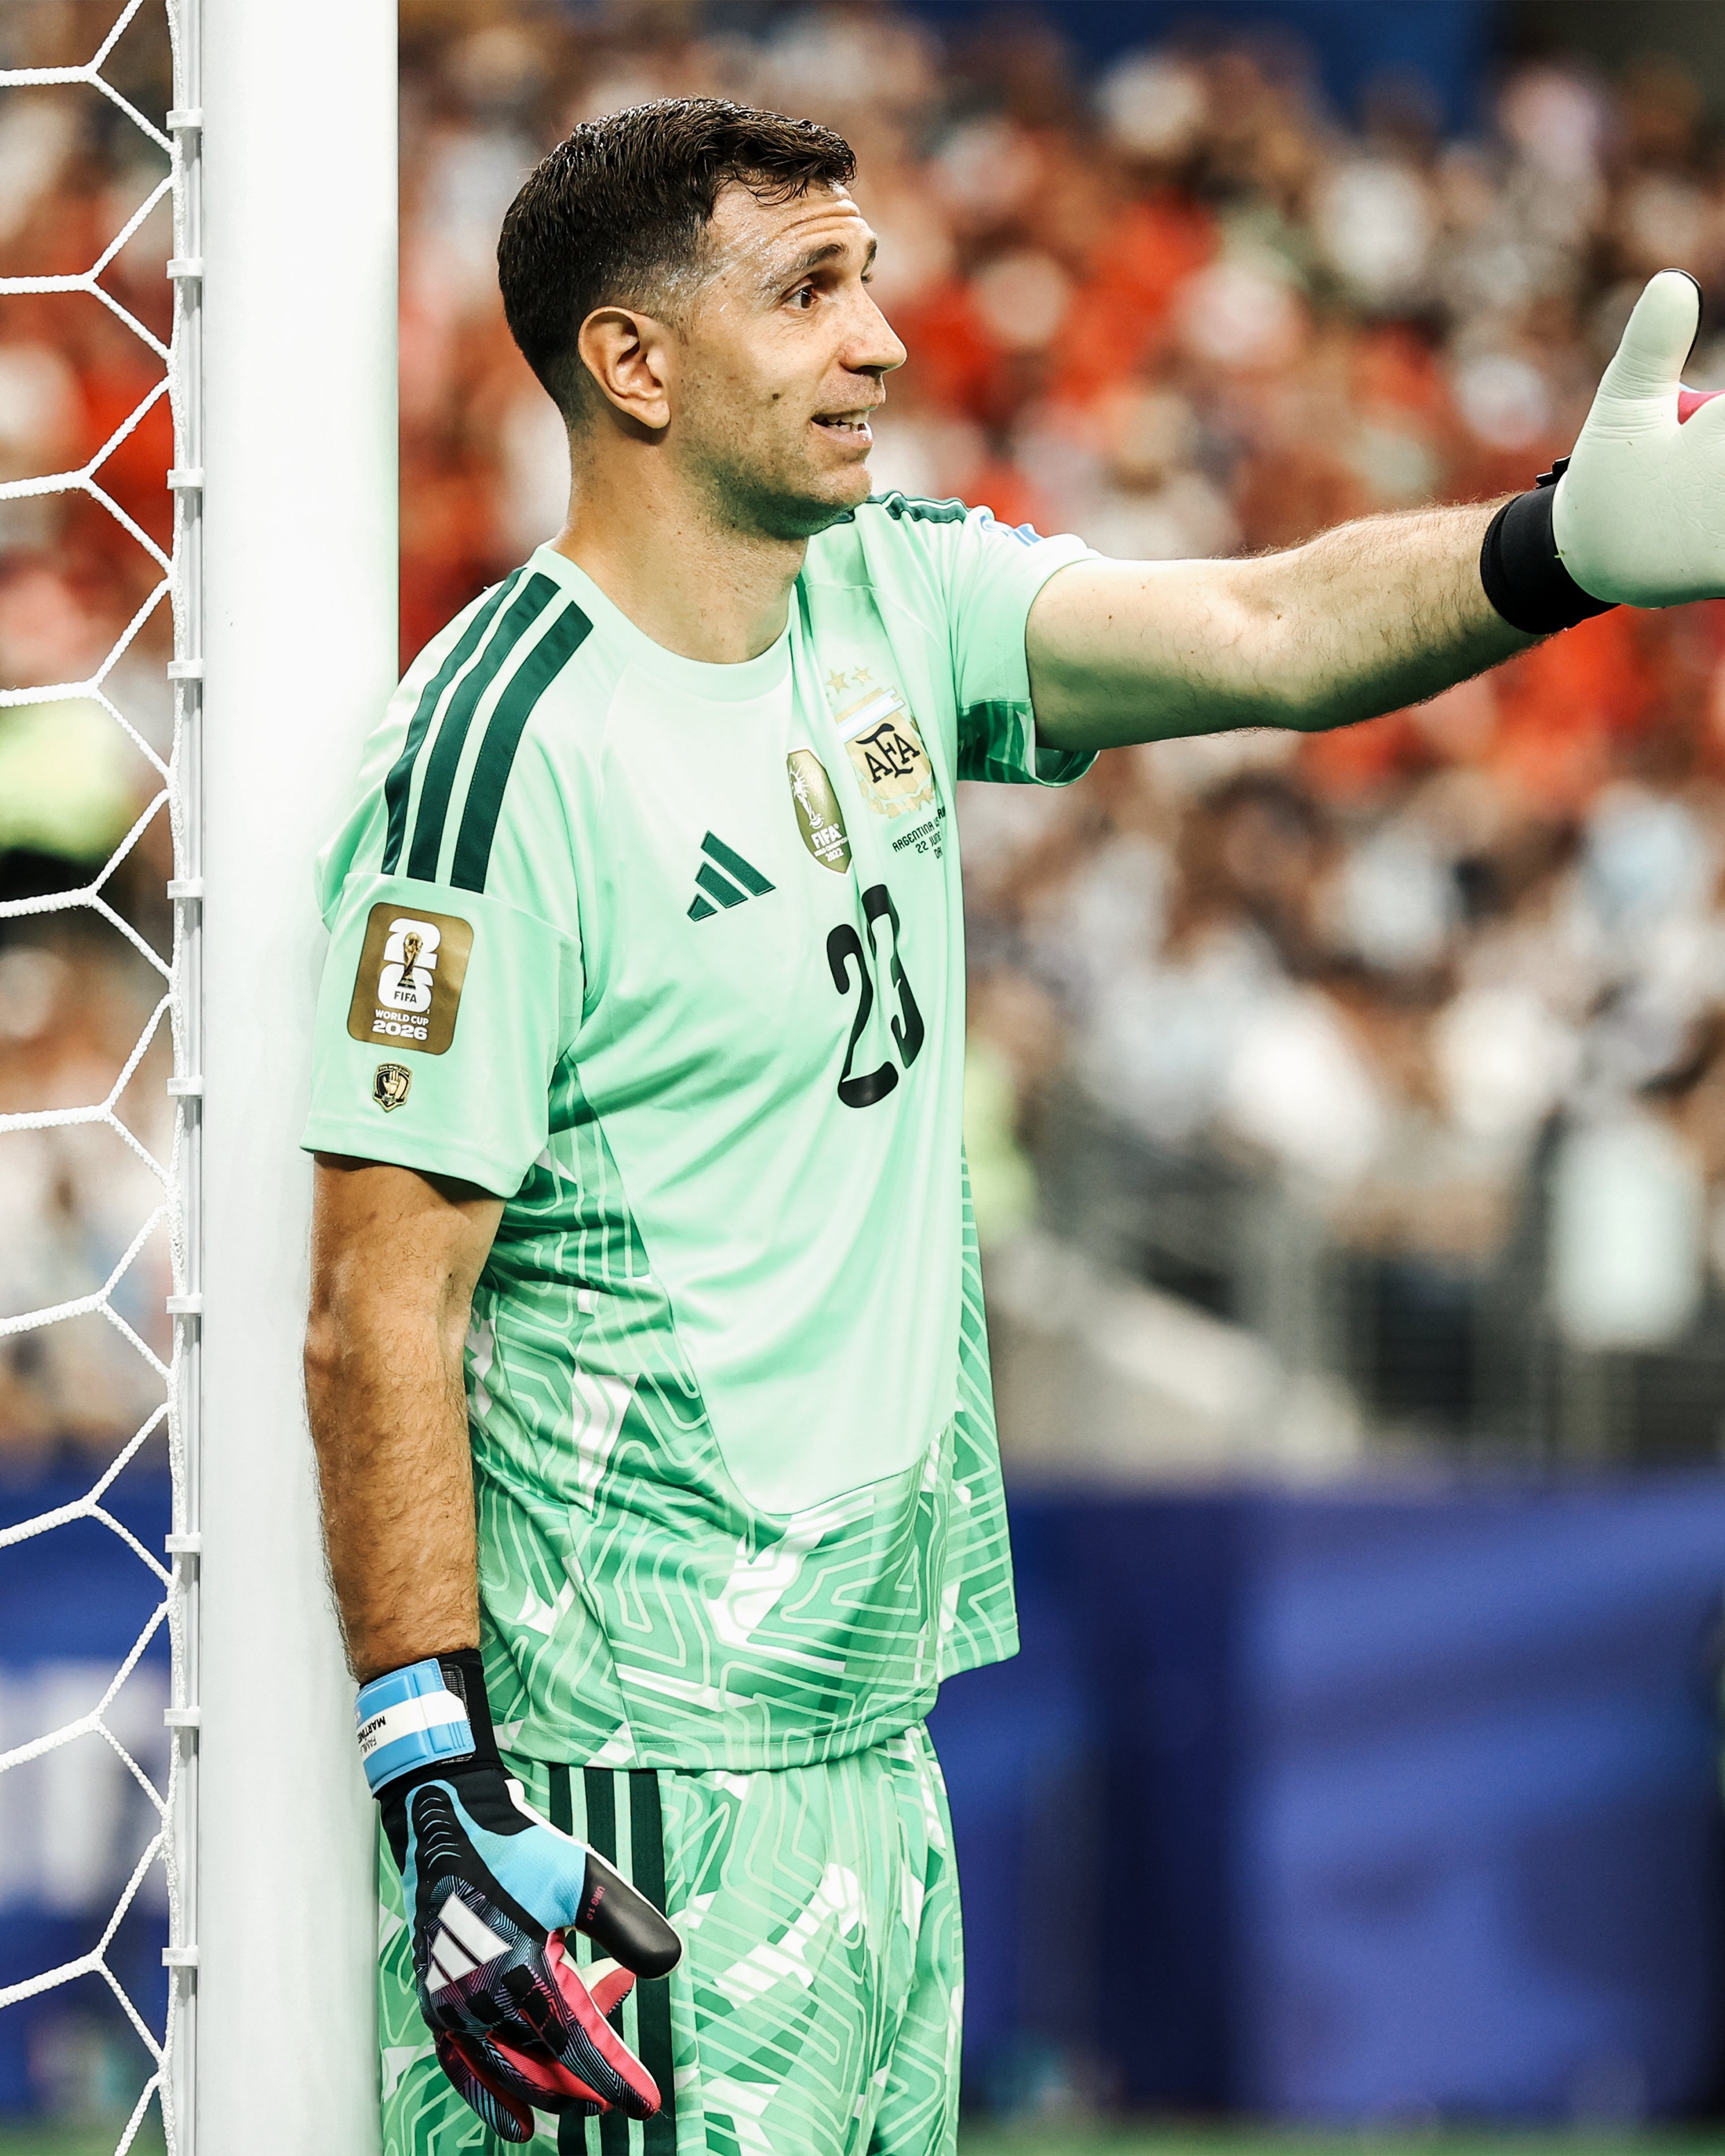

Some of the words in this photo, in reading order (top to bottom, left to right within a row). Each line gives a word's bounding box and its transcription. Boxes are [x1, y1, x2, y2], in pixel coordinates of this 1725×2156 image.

[856, 723, 920, 783] AFA
[811, 826, 842, 849] FIFA
[892, 822, 934, 852] ARGENTINA
[915, 840, 929, 853] 22
[929, 831, 941, 847] JUNE
[394, 991, 417, 1003] FIFA
[827, 884, 924, 1108] 23
[375, 1009, 410, 1022] WORLD
[410, 1015, 429, 1025] CUP
[372, 1019, 427, 1041] 2026
